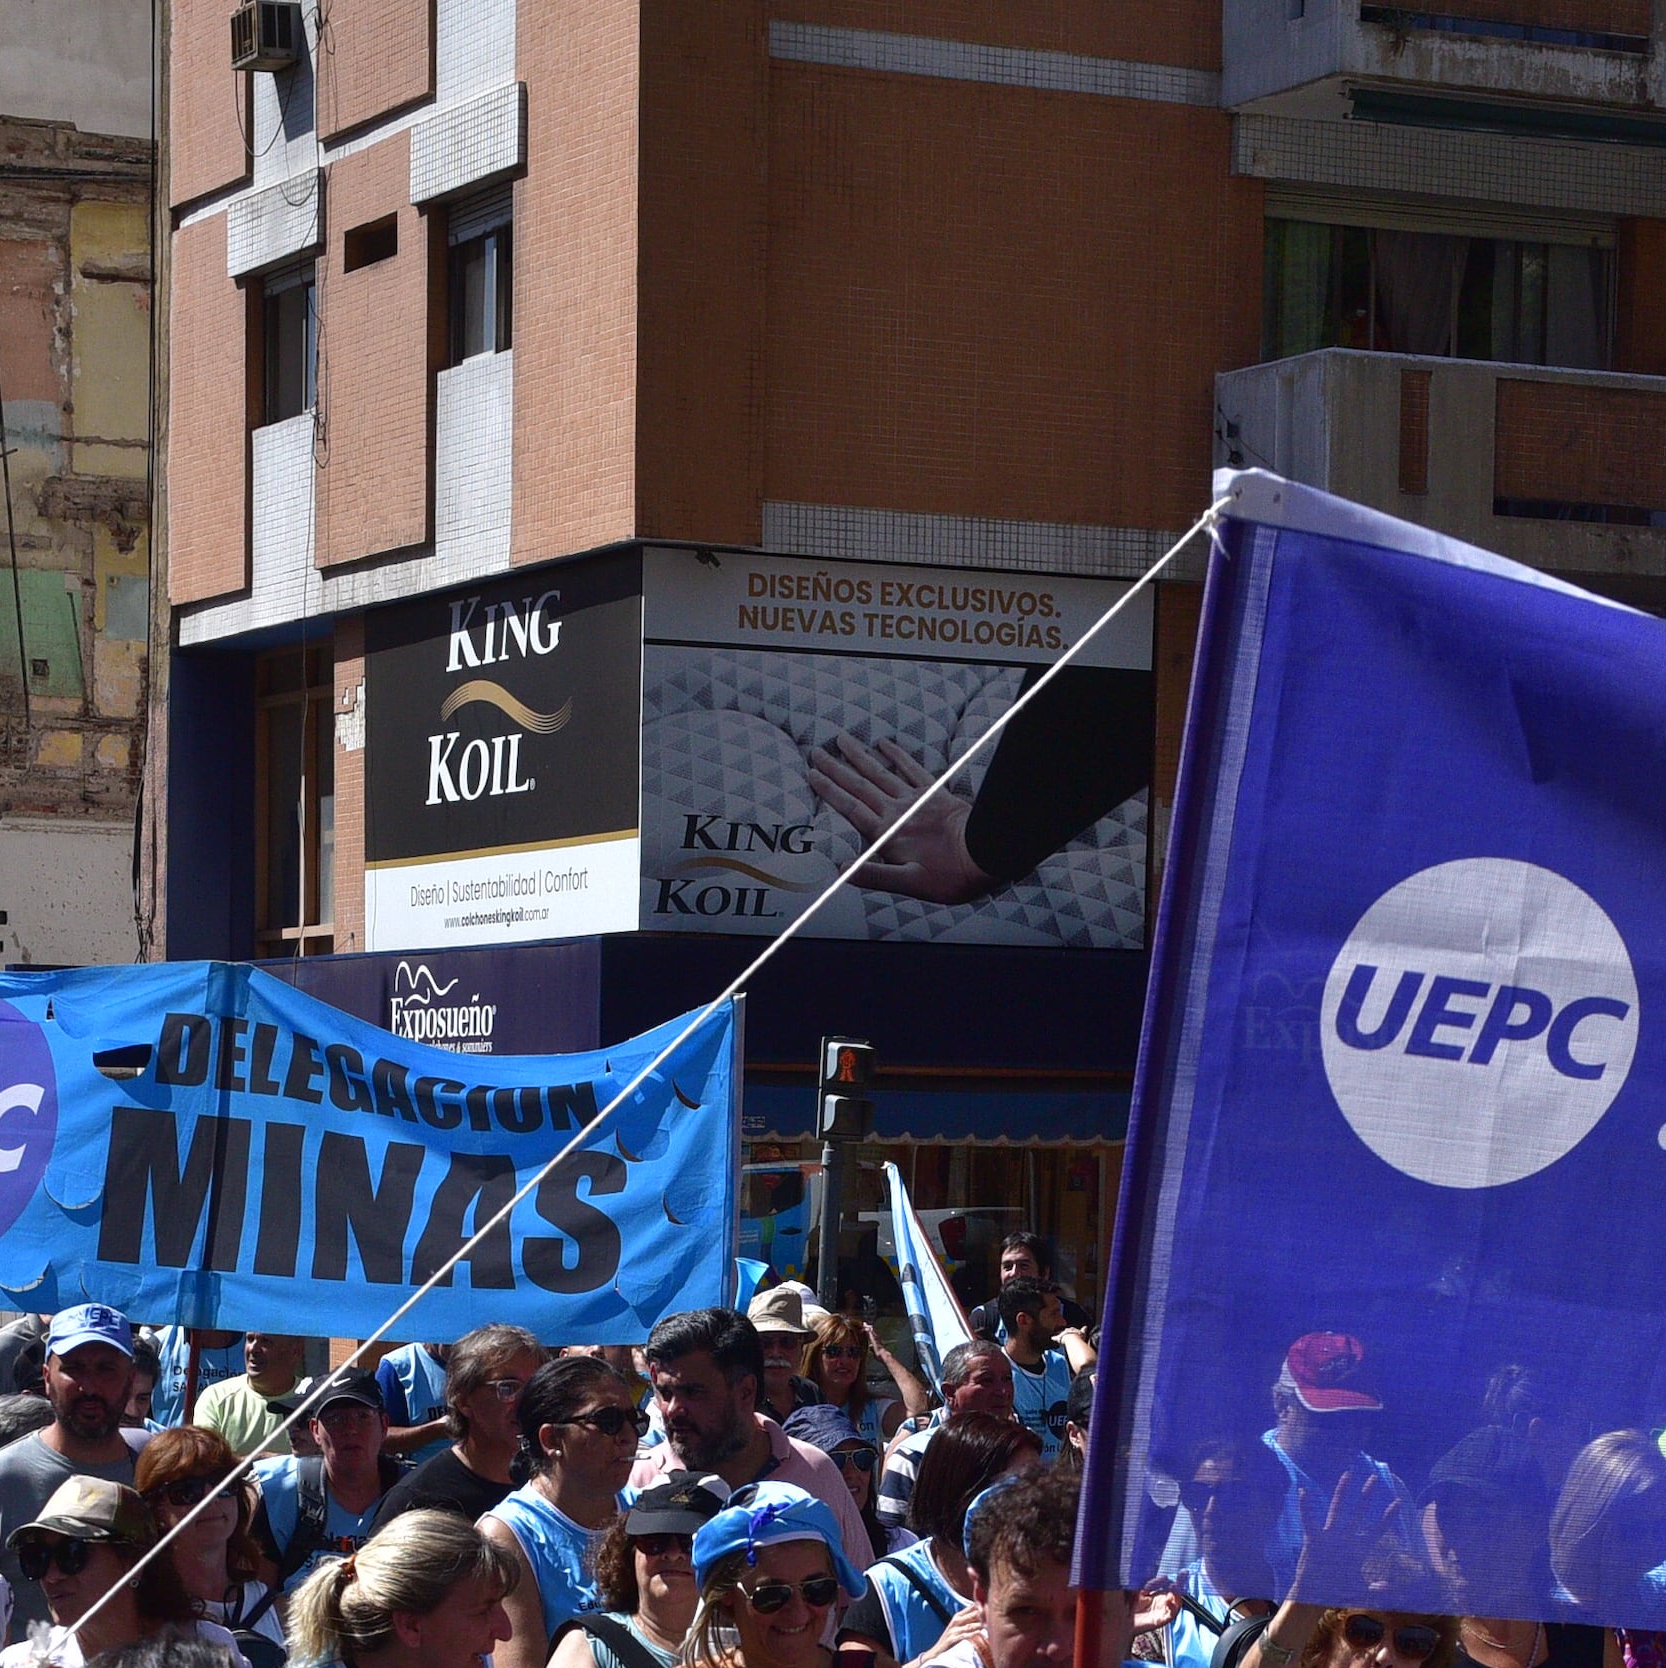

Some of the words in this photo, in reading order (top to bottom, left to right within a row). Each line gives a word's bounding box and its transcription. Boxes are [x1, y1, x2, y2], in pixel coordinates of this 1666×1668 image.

[747, 570, 873, 607] DISEÑOS
[880, 581, 1062, 618] EXCLUSIVOS.
[445, 588, 563, 673] KING
[737, 604, 857, 637] NUEVAS
[862, 612, 1069, 651] TECNOLOGÍAS.
[425, 731, 531, 806] KOIL
[680, 812, 816, 855] KING
[410, 877, 445, 908] Diseño
[452, 868, 537, 905] Sustentabilidad
[545, 865, 589, 897] Confort
[653, 877, 779, 918] KOIL
[391, 993, 493, 1046] Exposueño
[1333, 963, 1631, 1081] UEPC
[94, 1105, 629, 1295] MINAS
